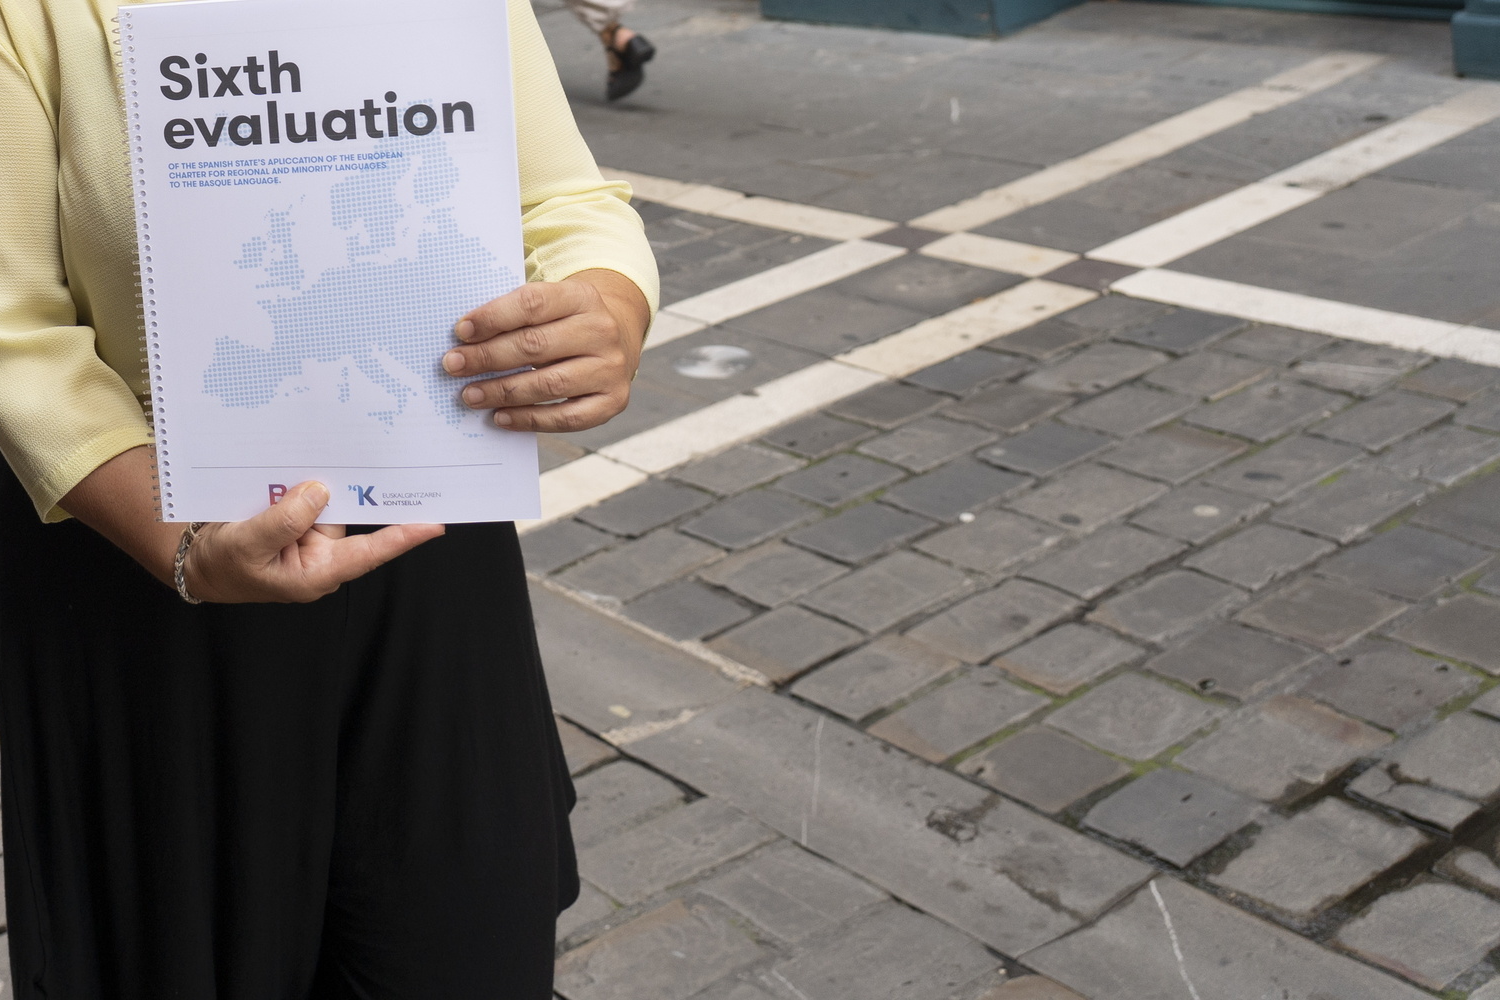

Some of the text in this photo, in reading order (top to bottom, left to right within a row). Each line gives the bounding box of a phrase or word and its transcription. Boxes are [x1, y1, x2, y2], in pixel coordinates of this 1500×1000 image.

[160, 50, 301, 100] Sixth
[163, 90, 475, 149] evaluation
[181, 162, 196, 170] THE
[198, 160, 233, 168] SPANISH
[268, 156, 324, 166] APLICCATION
[326, 154, 338, 162] OF
[357, 151, 403, 161] EUROPEAN
[169, 170, 206, 179] CHARTER
[228, 168, 270, 177] REGIONAL
[291, 165, 333, 174] MINORITY
[335, 162, 387, 172] LANGUAGES
[182, 180, 197, 188] THE
[199, 179, 232, 188] BASQUE
[233, 176, 281, 186] LANGUAGE.
